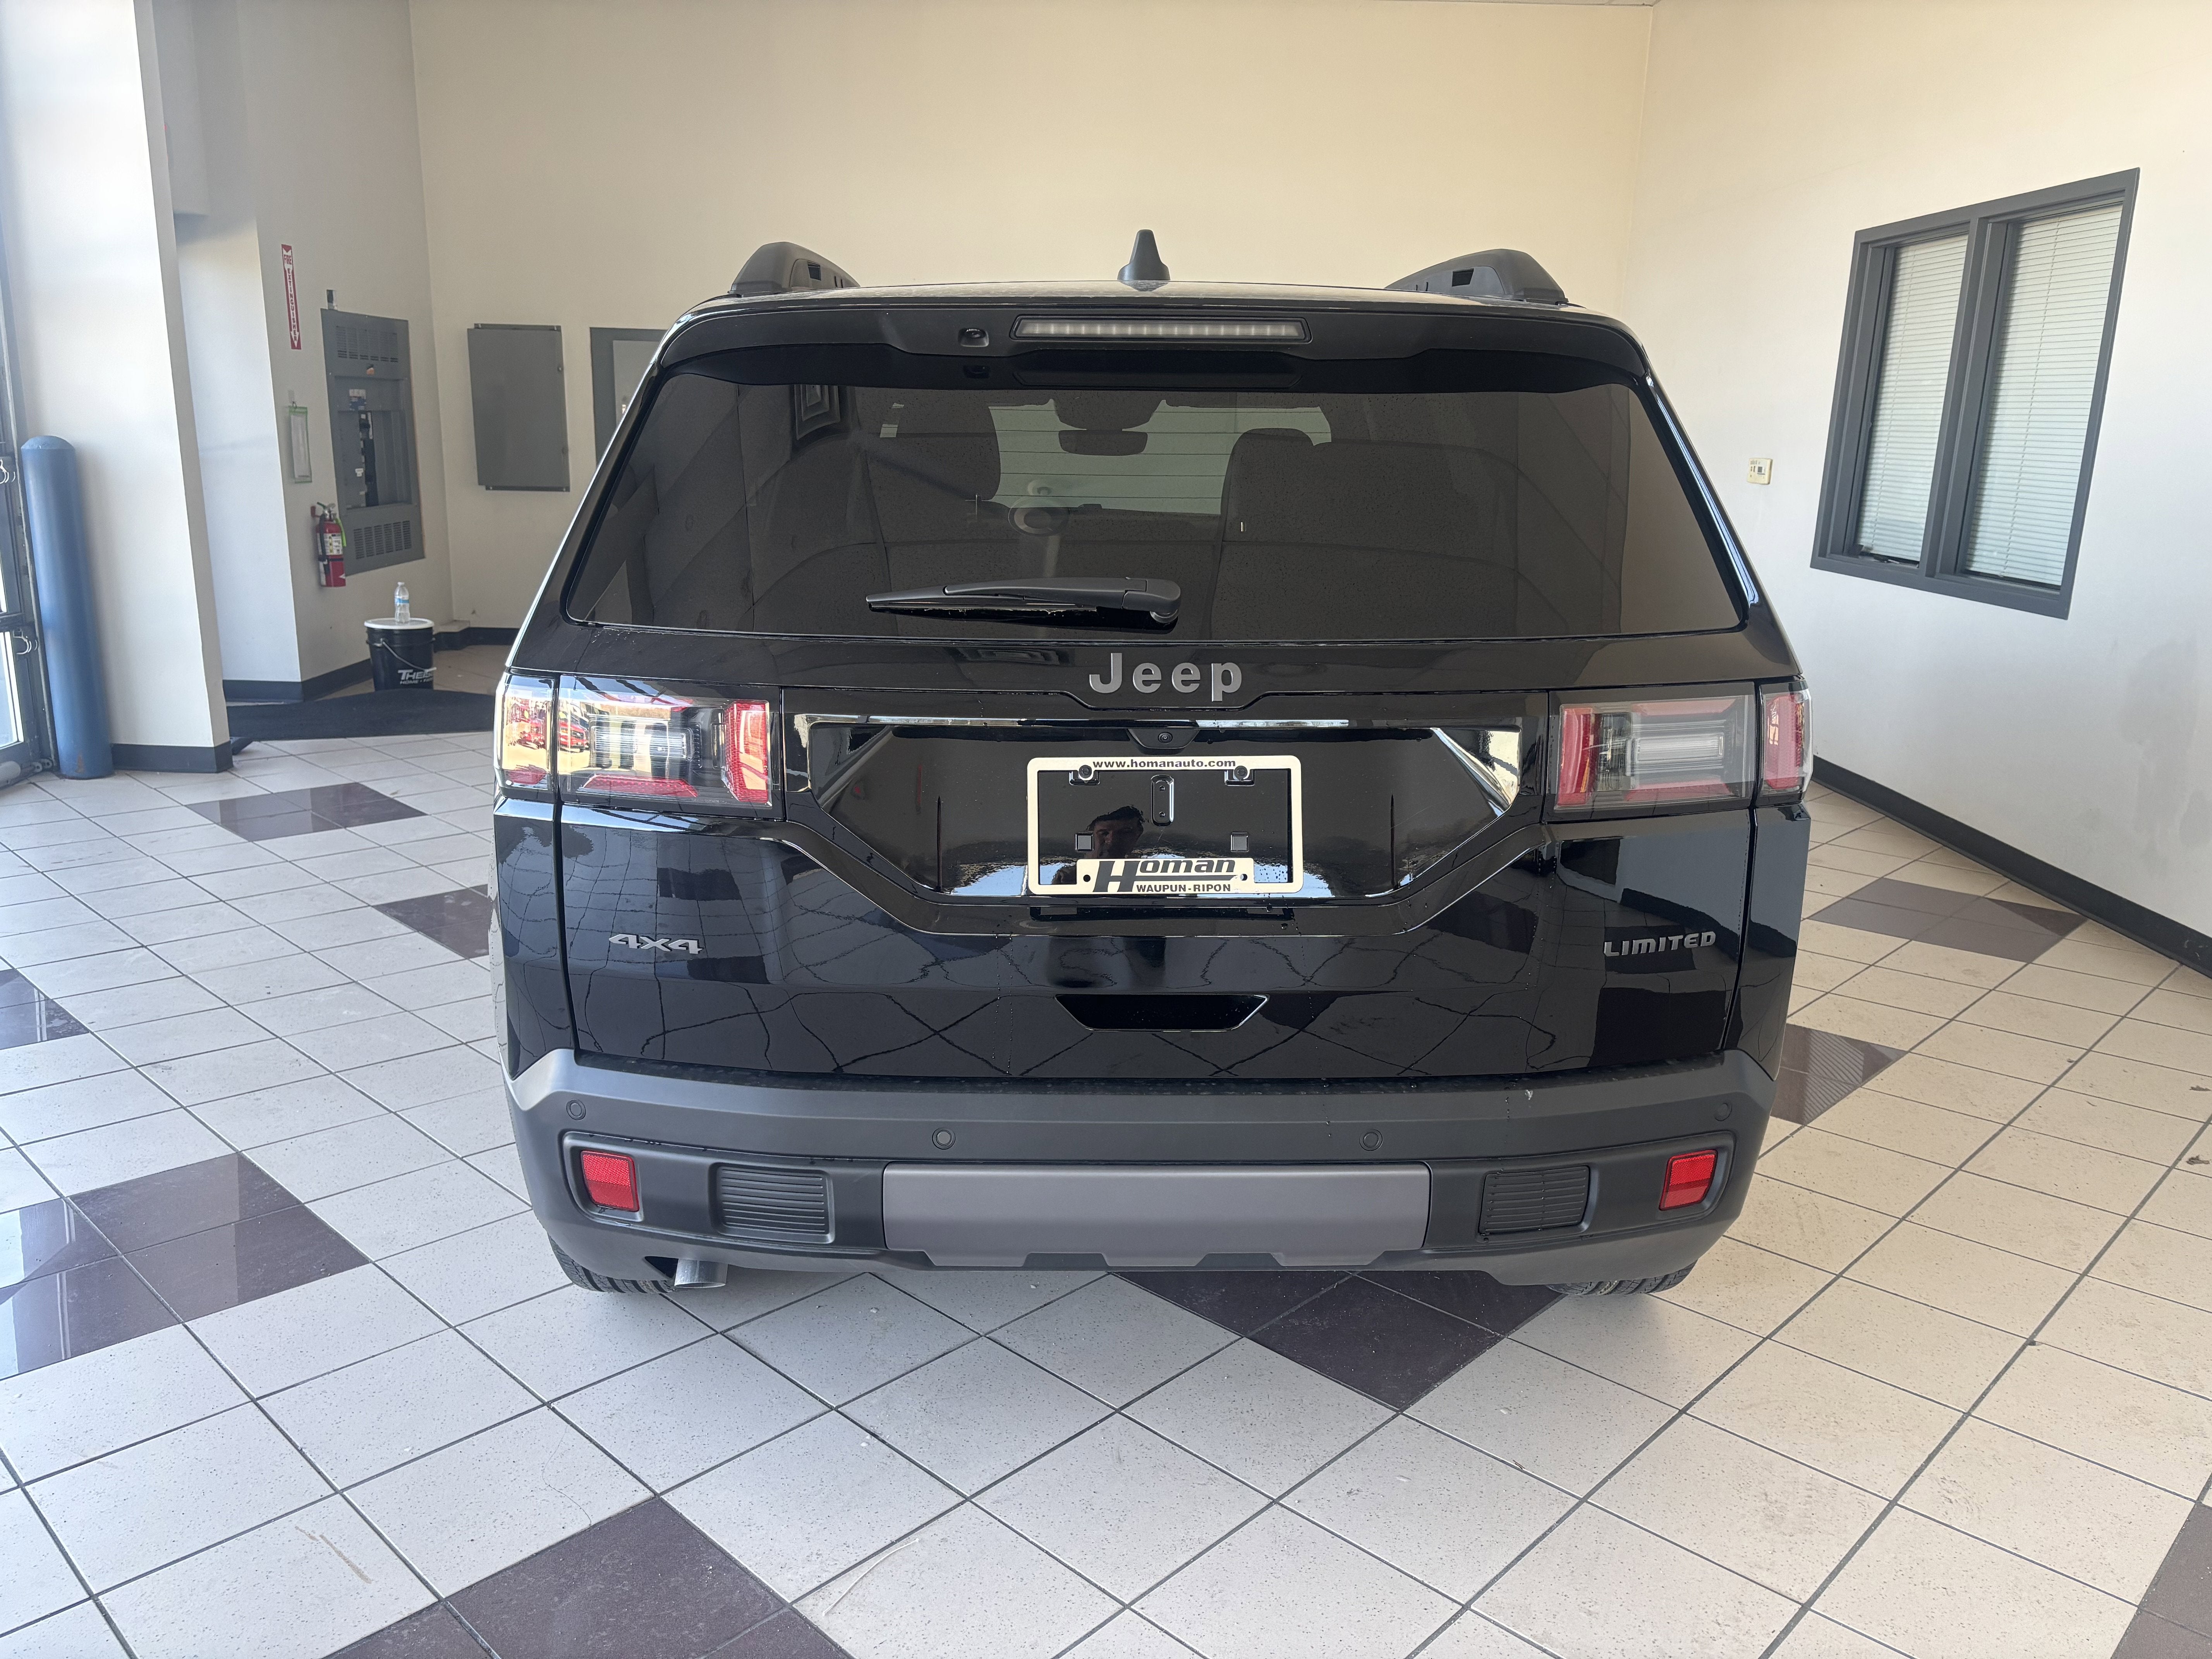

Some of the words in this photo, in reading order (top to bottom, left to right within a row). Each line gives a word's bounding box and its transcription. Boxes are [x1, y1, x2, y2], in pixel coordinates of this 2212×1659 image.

[287, 268, 297, 342] EXTINGUISHER
[1089, 653, 1242, 702] Jeep
[1092, 759, 1236, 768] www.homanauto.com
[1092, 860, 1236, 893] Homan
[1604, 931, 1716, 957] LIMITED
